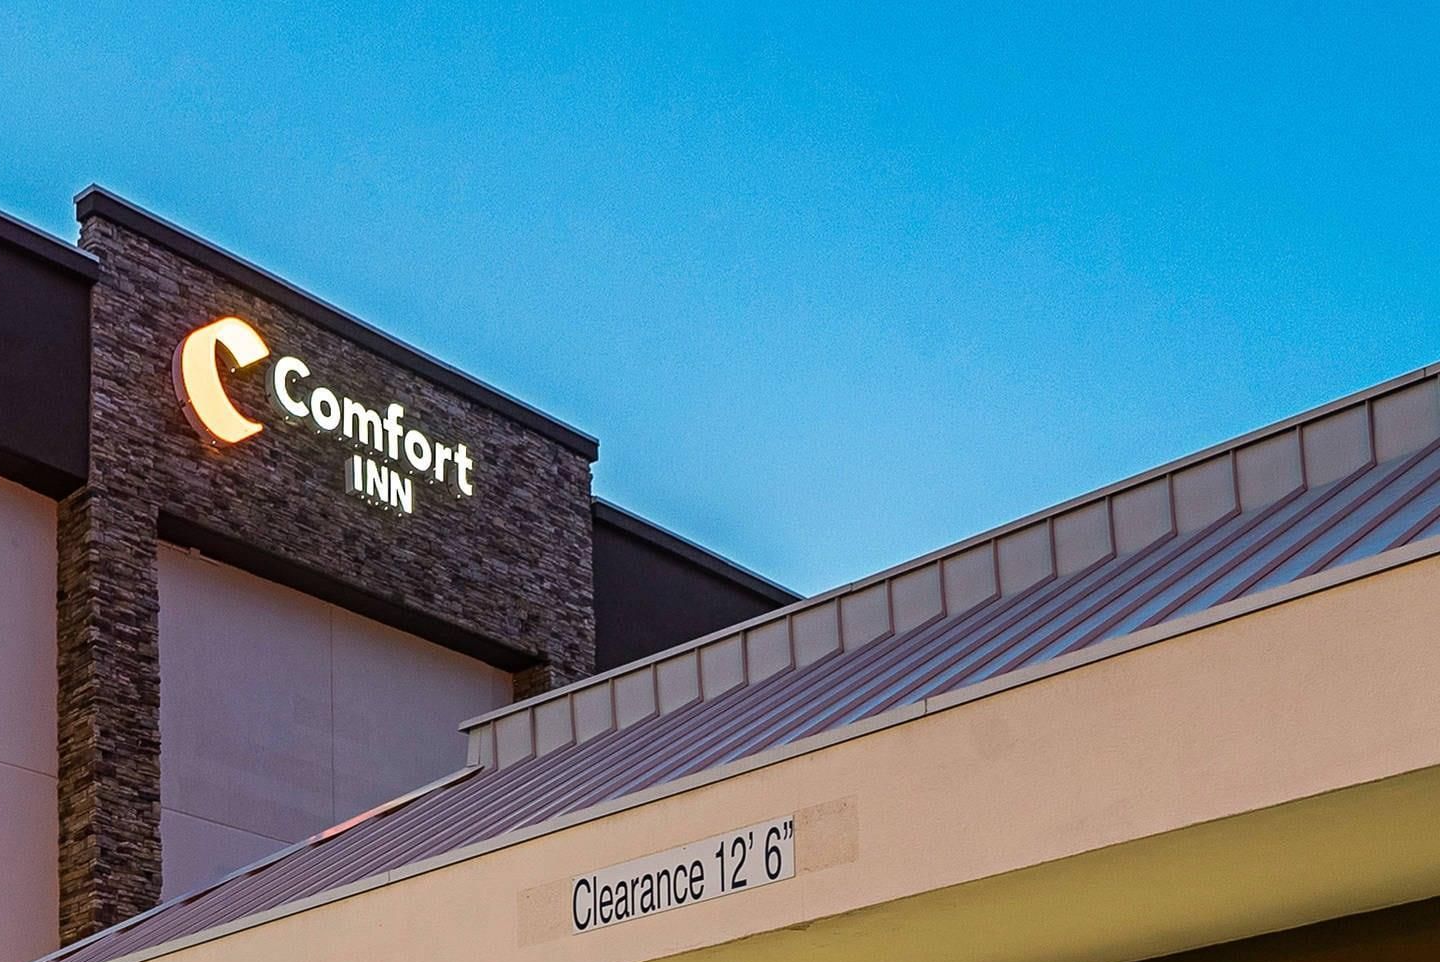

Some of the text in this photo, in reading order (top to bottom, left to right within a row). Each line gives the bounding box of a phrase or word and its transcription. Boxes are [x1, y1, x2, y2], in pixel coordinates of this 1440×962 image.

[272, 355, 474, 497] Comfort
[351, 454, 414, 515] INN
[572, 860, 705, 931] Clearance
